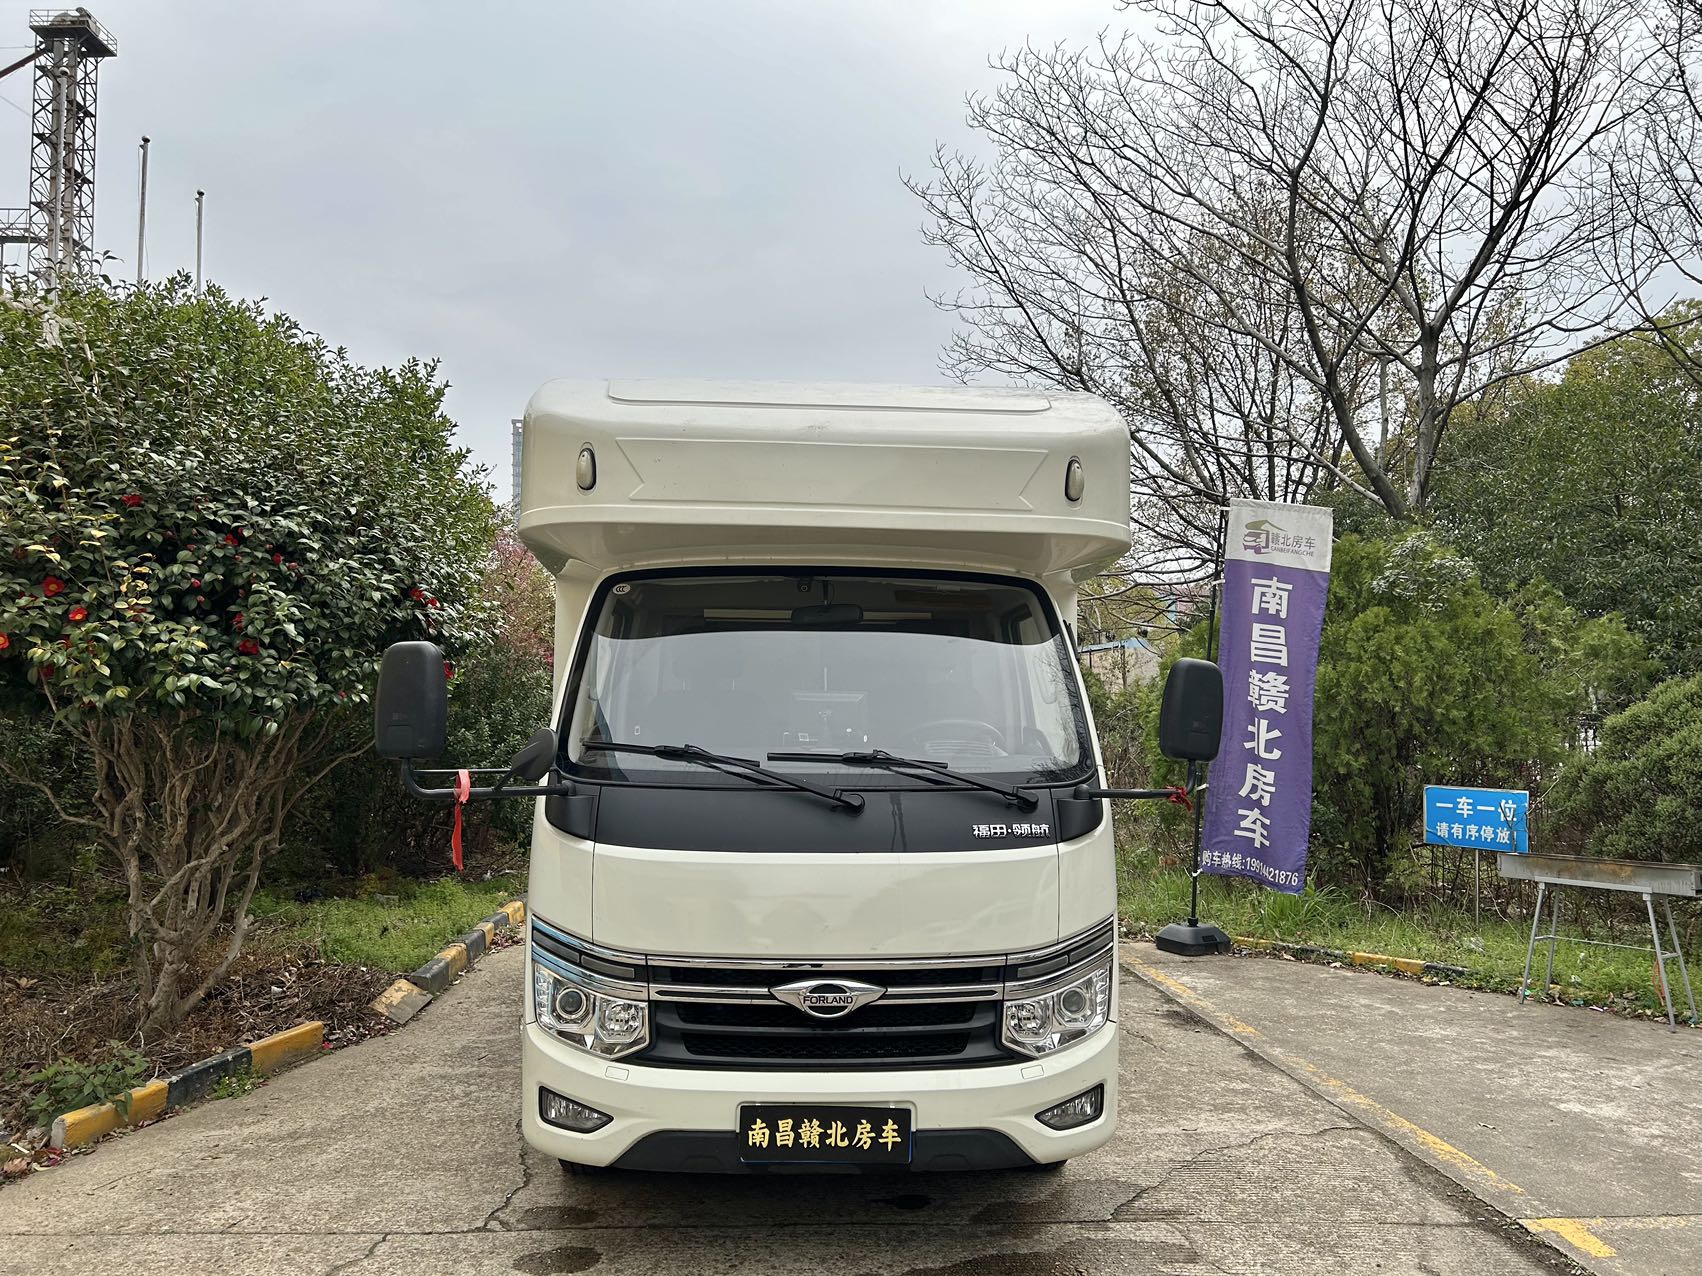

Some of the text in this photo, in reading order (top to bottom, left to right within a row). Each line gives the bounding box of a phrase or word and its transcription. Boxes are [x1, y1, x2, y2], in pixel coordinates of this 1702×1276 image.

[1233, 576, 1293, 849] 南昌赣北房车
[1435, 796, 1517, 821] 一车一位
[803, 995, 853, 1004] FORLAND
[747, 1117, 902, 1152] 南昌赣北房车
